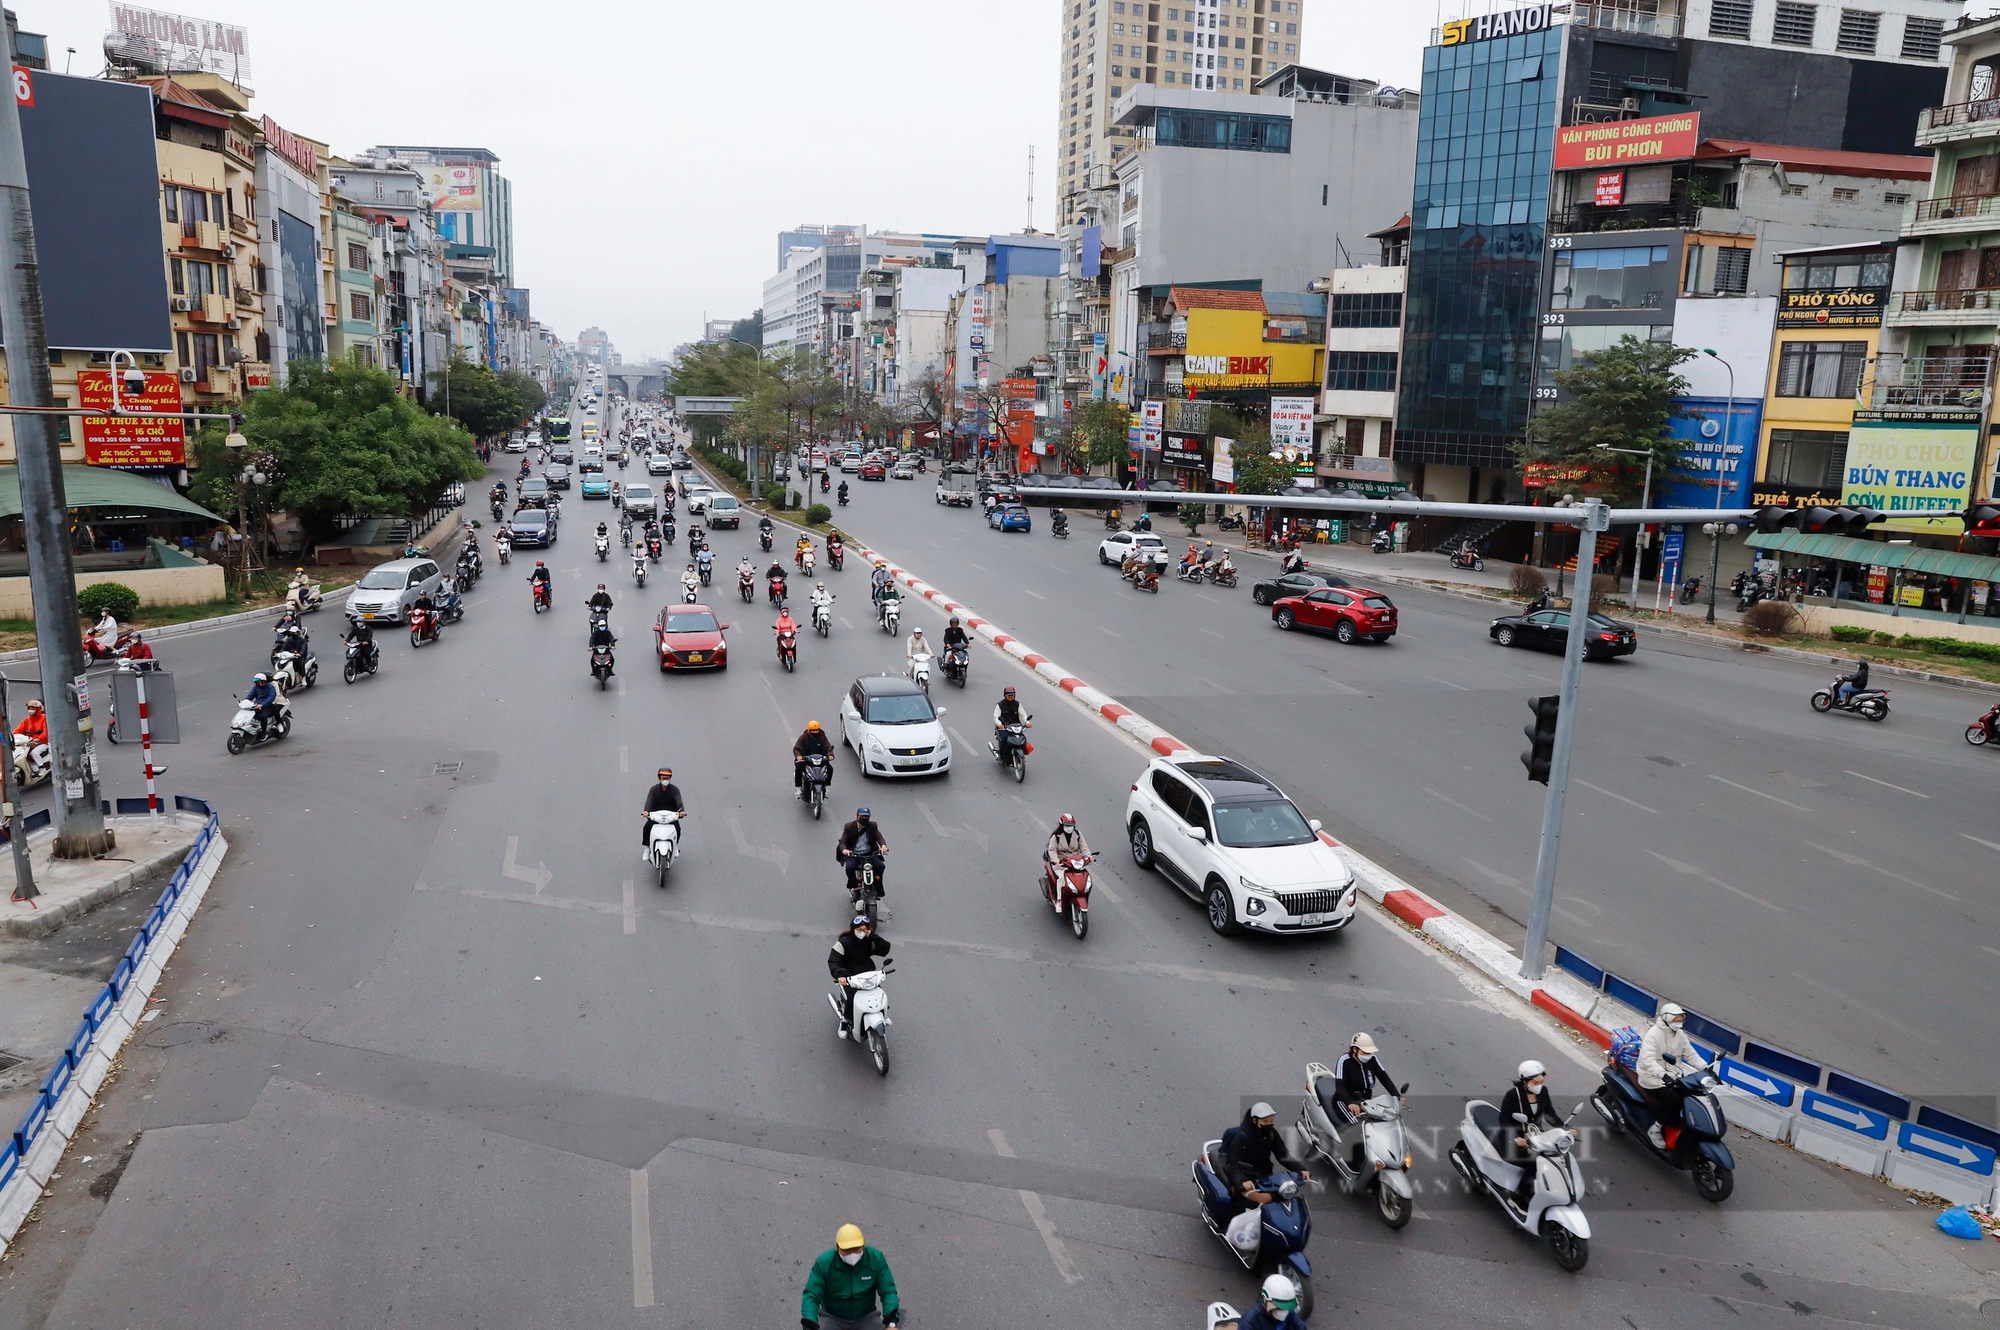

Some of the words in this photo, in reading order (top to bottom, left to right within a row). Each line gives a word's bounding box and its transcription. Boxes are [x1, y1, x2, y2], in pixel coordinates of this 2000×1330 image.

[115, 6, 198, 47] KHƯƠNG
[202, 23, 244, 55] LÂM
[1443, 18, 1473, 46] ST
[1476, 4, 1550, 40] HANOI
[1562, 129, 1582, 144] VĂN
[1584, 125, 1620, 142] PHÒNG
[1622, 122, 1652, 138] CÔNG
[1654, 117, 1692, 134] CHỨNG
[1585, 143, 1612, 161] BÙI
[1616, 140, 1663, 158] PHƠN
[1550, 237, 1572, 248] 393
[1788, 290, 1825, 306] PHỞ
[1827, 287, 1876, 306] TỐNG
[1542, 314, 1565, 324] 393
[1794, 311, 1816, 319] NGON
[1829, 316, 1854, 324] HƯƠNG
[1856, 317, 1864, 326] VỊ
[1864, 316, 1880, 324] XƯA
[1229, 356, 1270, 374] BUK
[1183, 378, 1204, 386] BUFFET
[1536, 388, 1558, 398] 393
[1857, 437, 1900, 460] PHỞ
[1904, 440, 1966, 463] CHÚC
[1348, 481, 1364, 490] ĐỒNG
[1848, 464, 1890, 486] BÚN
[1894, 470, 1966, 490] THANG
[1848, 491, 1886, 510] CƠM
[1890, 495, 1962, 510] BUFFET
